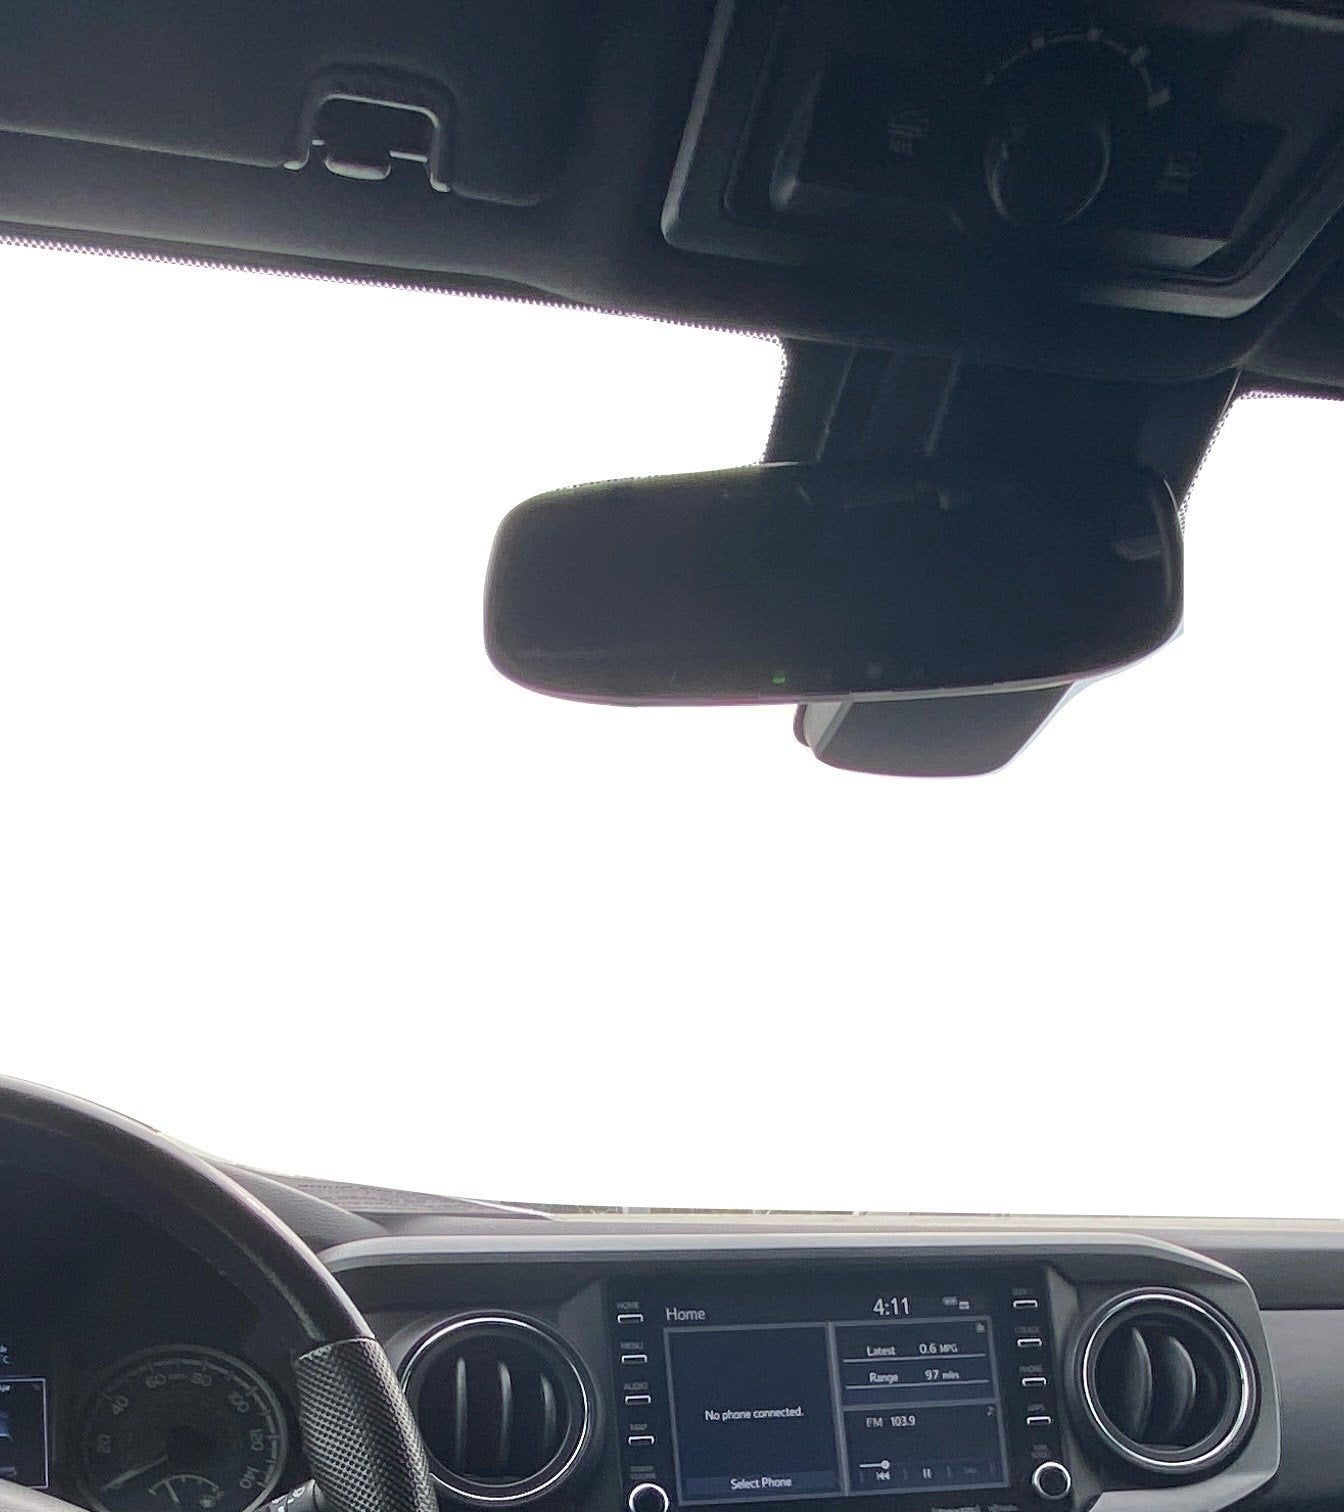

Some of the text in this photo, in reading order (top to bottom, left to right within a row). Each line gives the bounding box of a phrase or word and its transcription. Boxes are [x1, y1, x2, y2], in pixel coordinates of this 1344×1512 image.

[665, 1306, 706, 1322] Home
[873, 1296, 910, 1316] 4:11
[866, 1343, 958, 1356] Latest 0.6 MPG
[869, 1371, 899, 1384] Range
[924, 1368, 939, 1381] 97
[705, 1406, 805, 1422] No phone connected.
[866, 1415, 916, 1428] FM 103.9
[730, 1476, 792, 1490] Select Phone
